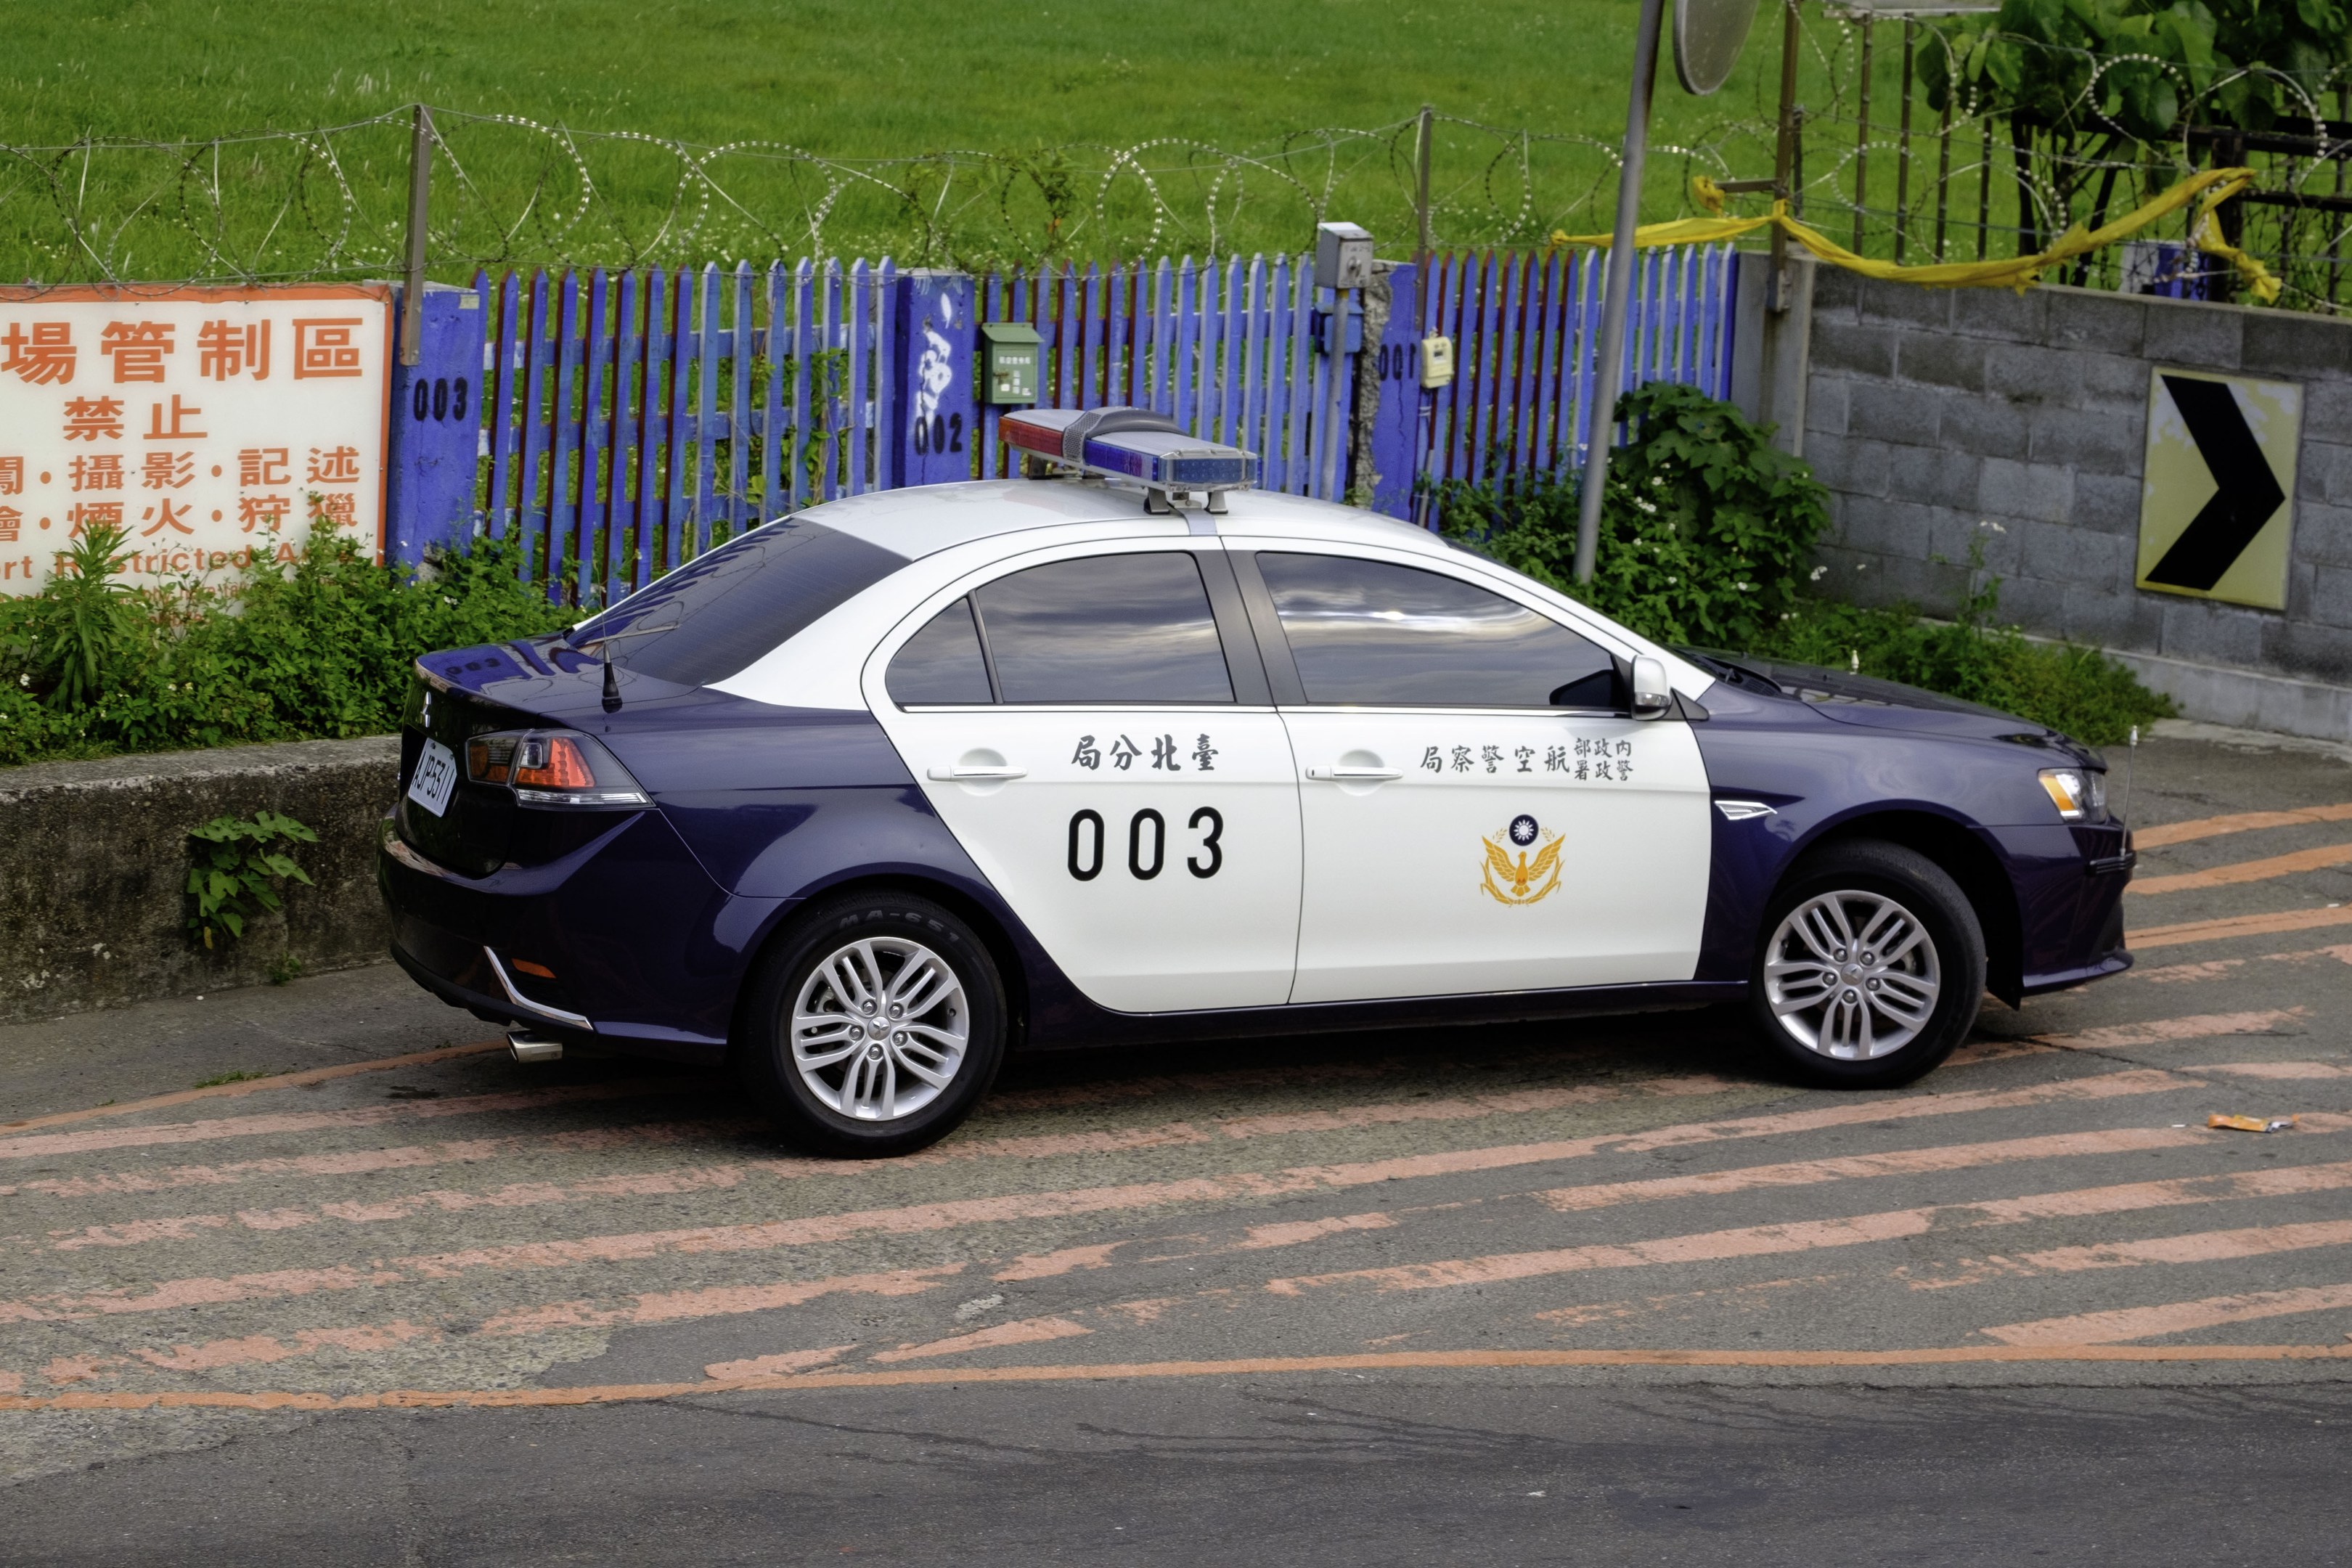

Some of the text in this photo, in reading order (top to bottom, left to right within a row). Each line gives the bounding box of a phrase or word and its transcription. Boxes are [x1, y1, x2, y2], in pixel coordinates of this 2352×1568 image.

[1, 317, 363, 385] 場管制區
[63, 394, 208, 441] 禁止
[413, 377, 468, 422] 003
[915, 412, 962, 455] 002
[0, 555, 33, 580] rt
[55, 544, 252, 578] Rstricted
[1068, 806, 1224, 881] 003
